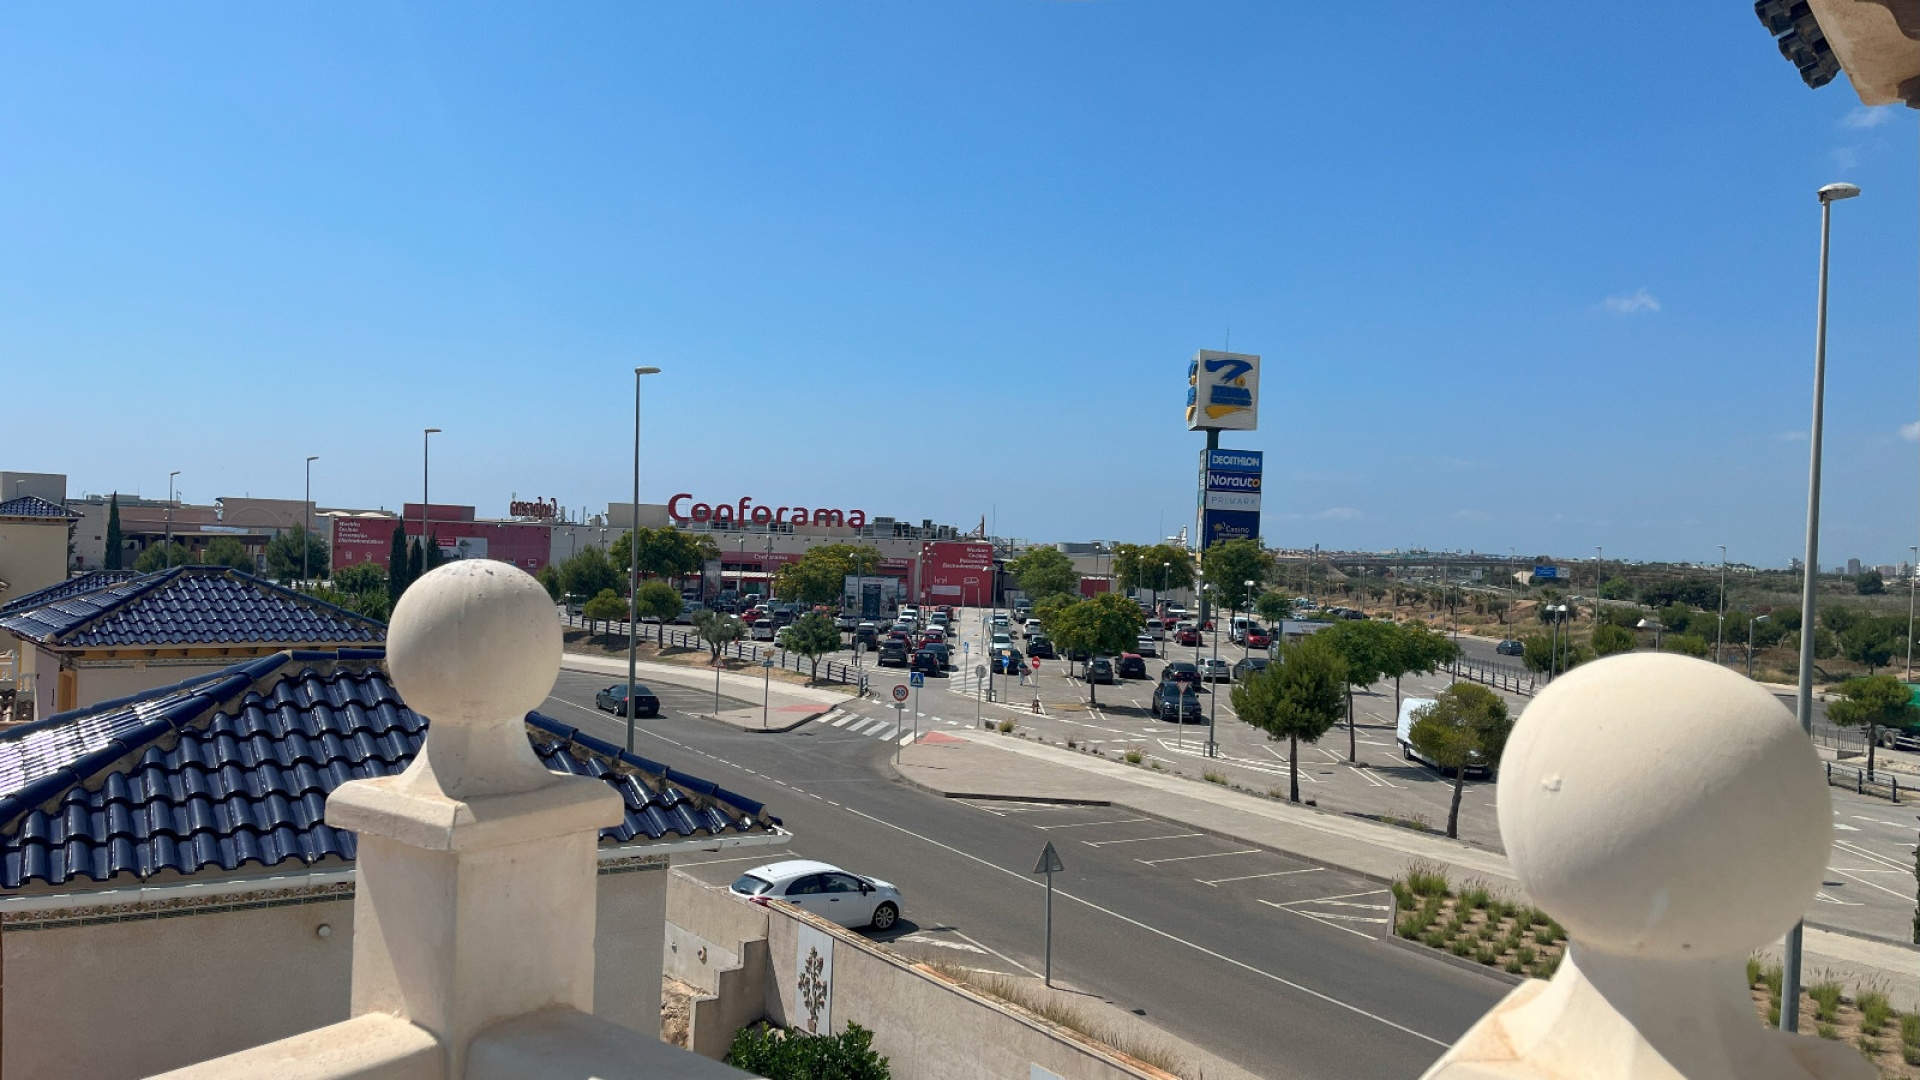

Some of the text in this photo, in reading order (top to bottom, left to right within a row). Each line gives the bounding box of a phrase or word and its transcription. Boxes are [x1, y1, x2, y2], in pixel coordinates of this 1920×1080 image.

[1212, 455, 1260, 467] DECATHLON
[1210, 474, 1261, 488] Norauto
[1211, 496, 1256, 506] PRIMARK
[667, 493, 866, 529] Conforama
[1225, 525, 1250, 534] Casino
[895, 689, 906, 697] 20
